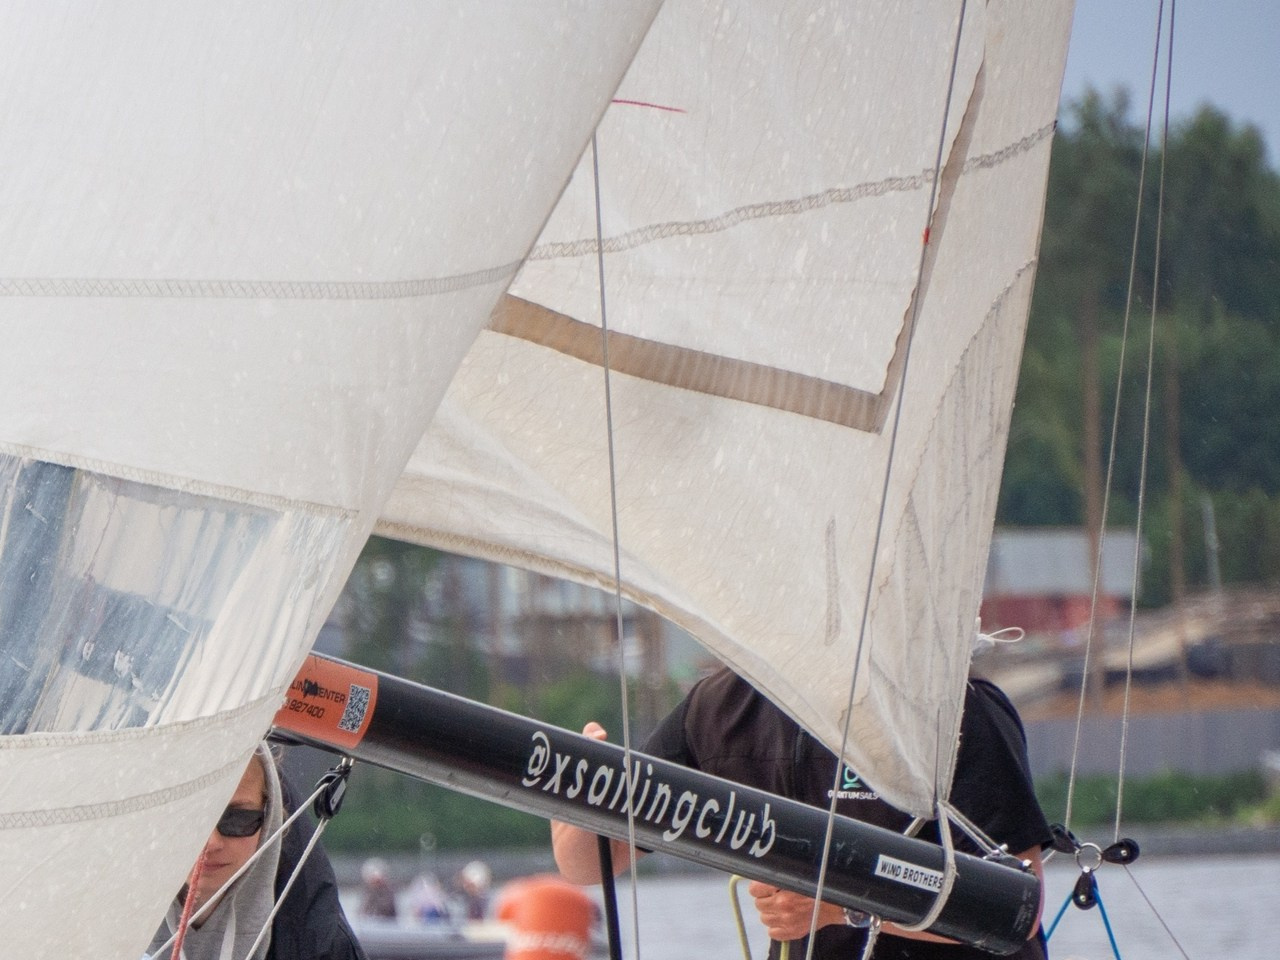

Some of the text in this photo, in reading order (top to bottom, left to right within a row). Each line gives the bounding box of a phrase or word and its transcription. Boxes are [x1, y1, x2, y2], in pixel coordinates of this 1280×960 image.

[521, 731, 776, 858] @xsailingclub
[880, 861, 943, 889] WIND BROTHERS
